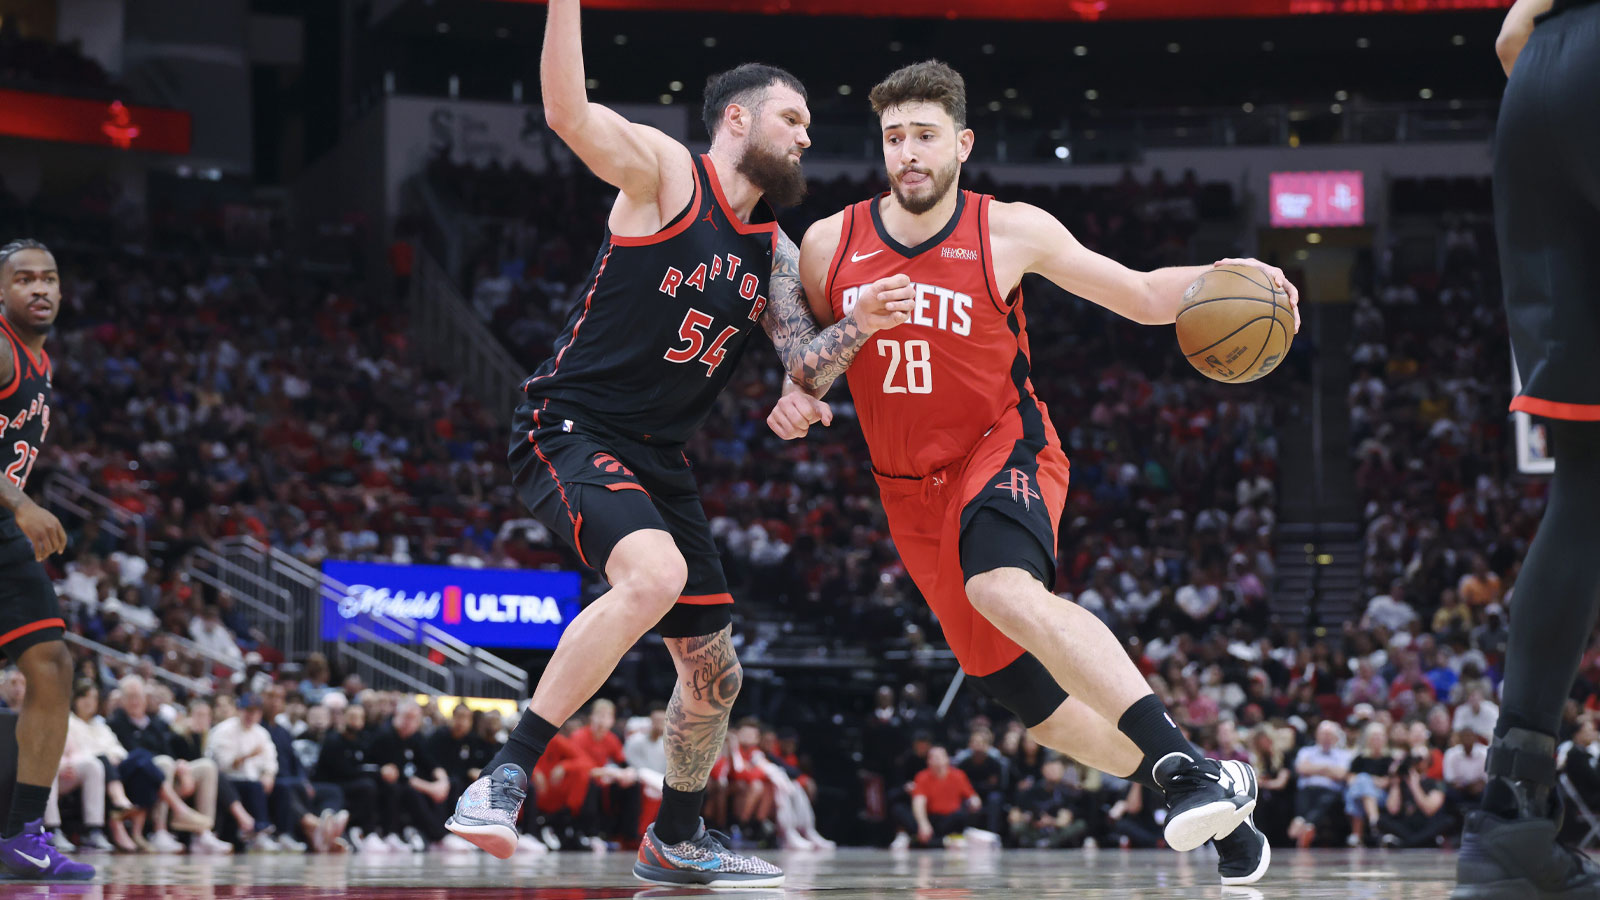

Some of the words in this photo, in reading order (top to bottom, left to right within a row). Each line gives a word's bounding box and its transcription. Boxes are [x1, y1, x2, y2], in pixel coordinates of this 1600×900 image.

[659, 253, 767, 322] RAPTOR
[842, 282, 973, 337] RETS
[664, 308, 740, 377] 54
[877, 339, 933, 394] 28
[5, 440, 39, 491] 21
[465, 593, 562, 624] ULTRA
